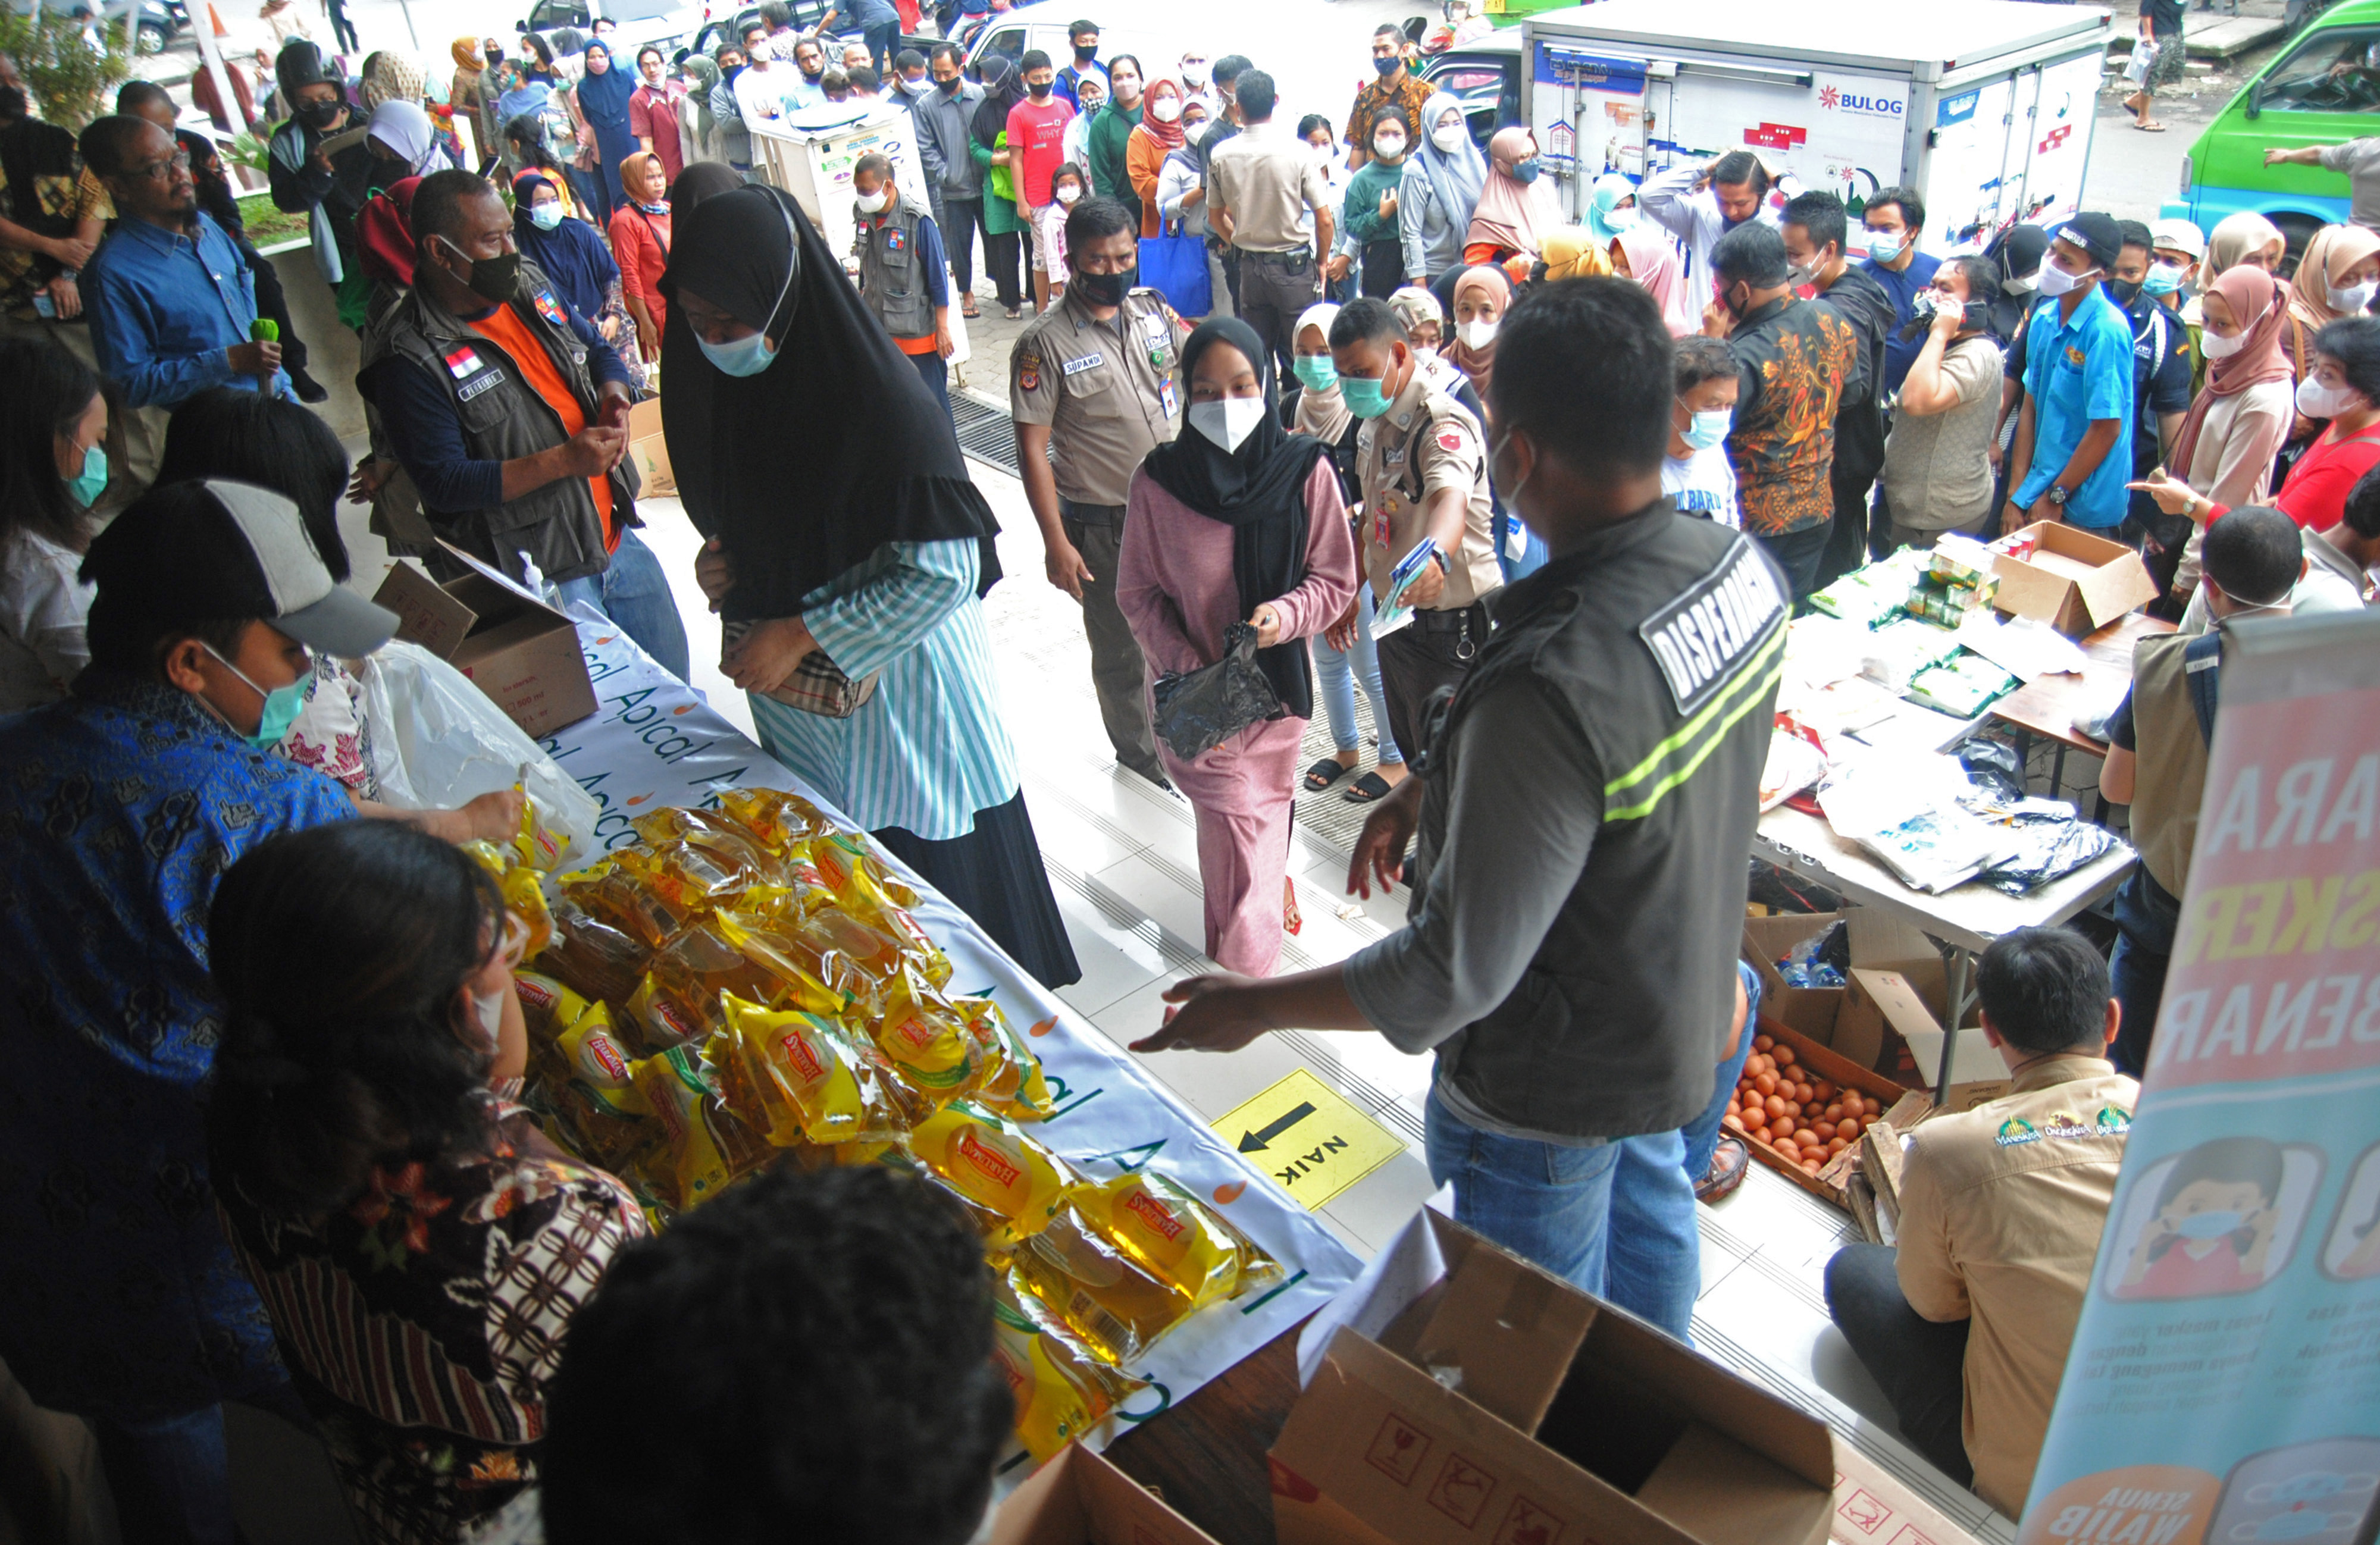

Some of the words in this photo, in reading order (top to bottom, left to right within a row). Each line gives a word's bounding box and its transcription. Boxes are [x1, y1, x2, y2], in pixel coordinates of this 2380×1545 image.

[1841, 94, 1903, 114] BULOG
[1687, 490, 1721, 510] BARU
[517, 697, 532, 708] 500
[602, 686, 715, 765] Apical
[592, 1039, 625, 1077] HARUMAS
[785, 1034, 819, 1082] HARUMAS
[962, 1140, 1016, 1184] HARUMAS
[1274, 1135, 1349, 1186] NAIK
[1132, 1196, 1180, 1237] HARUMAS
